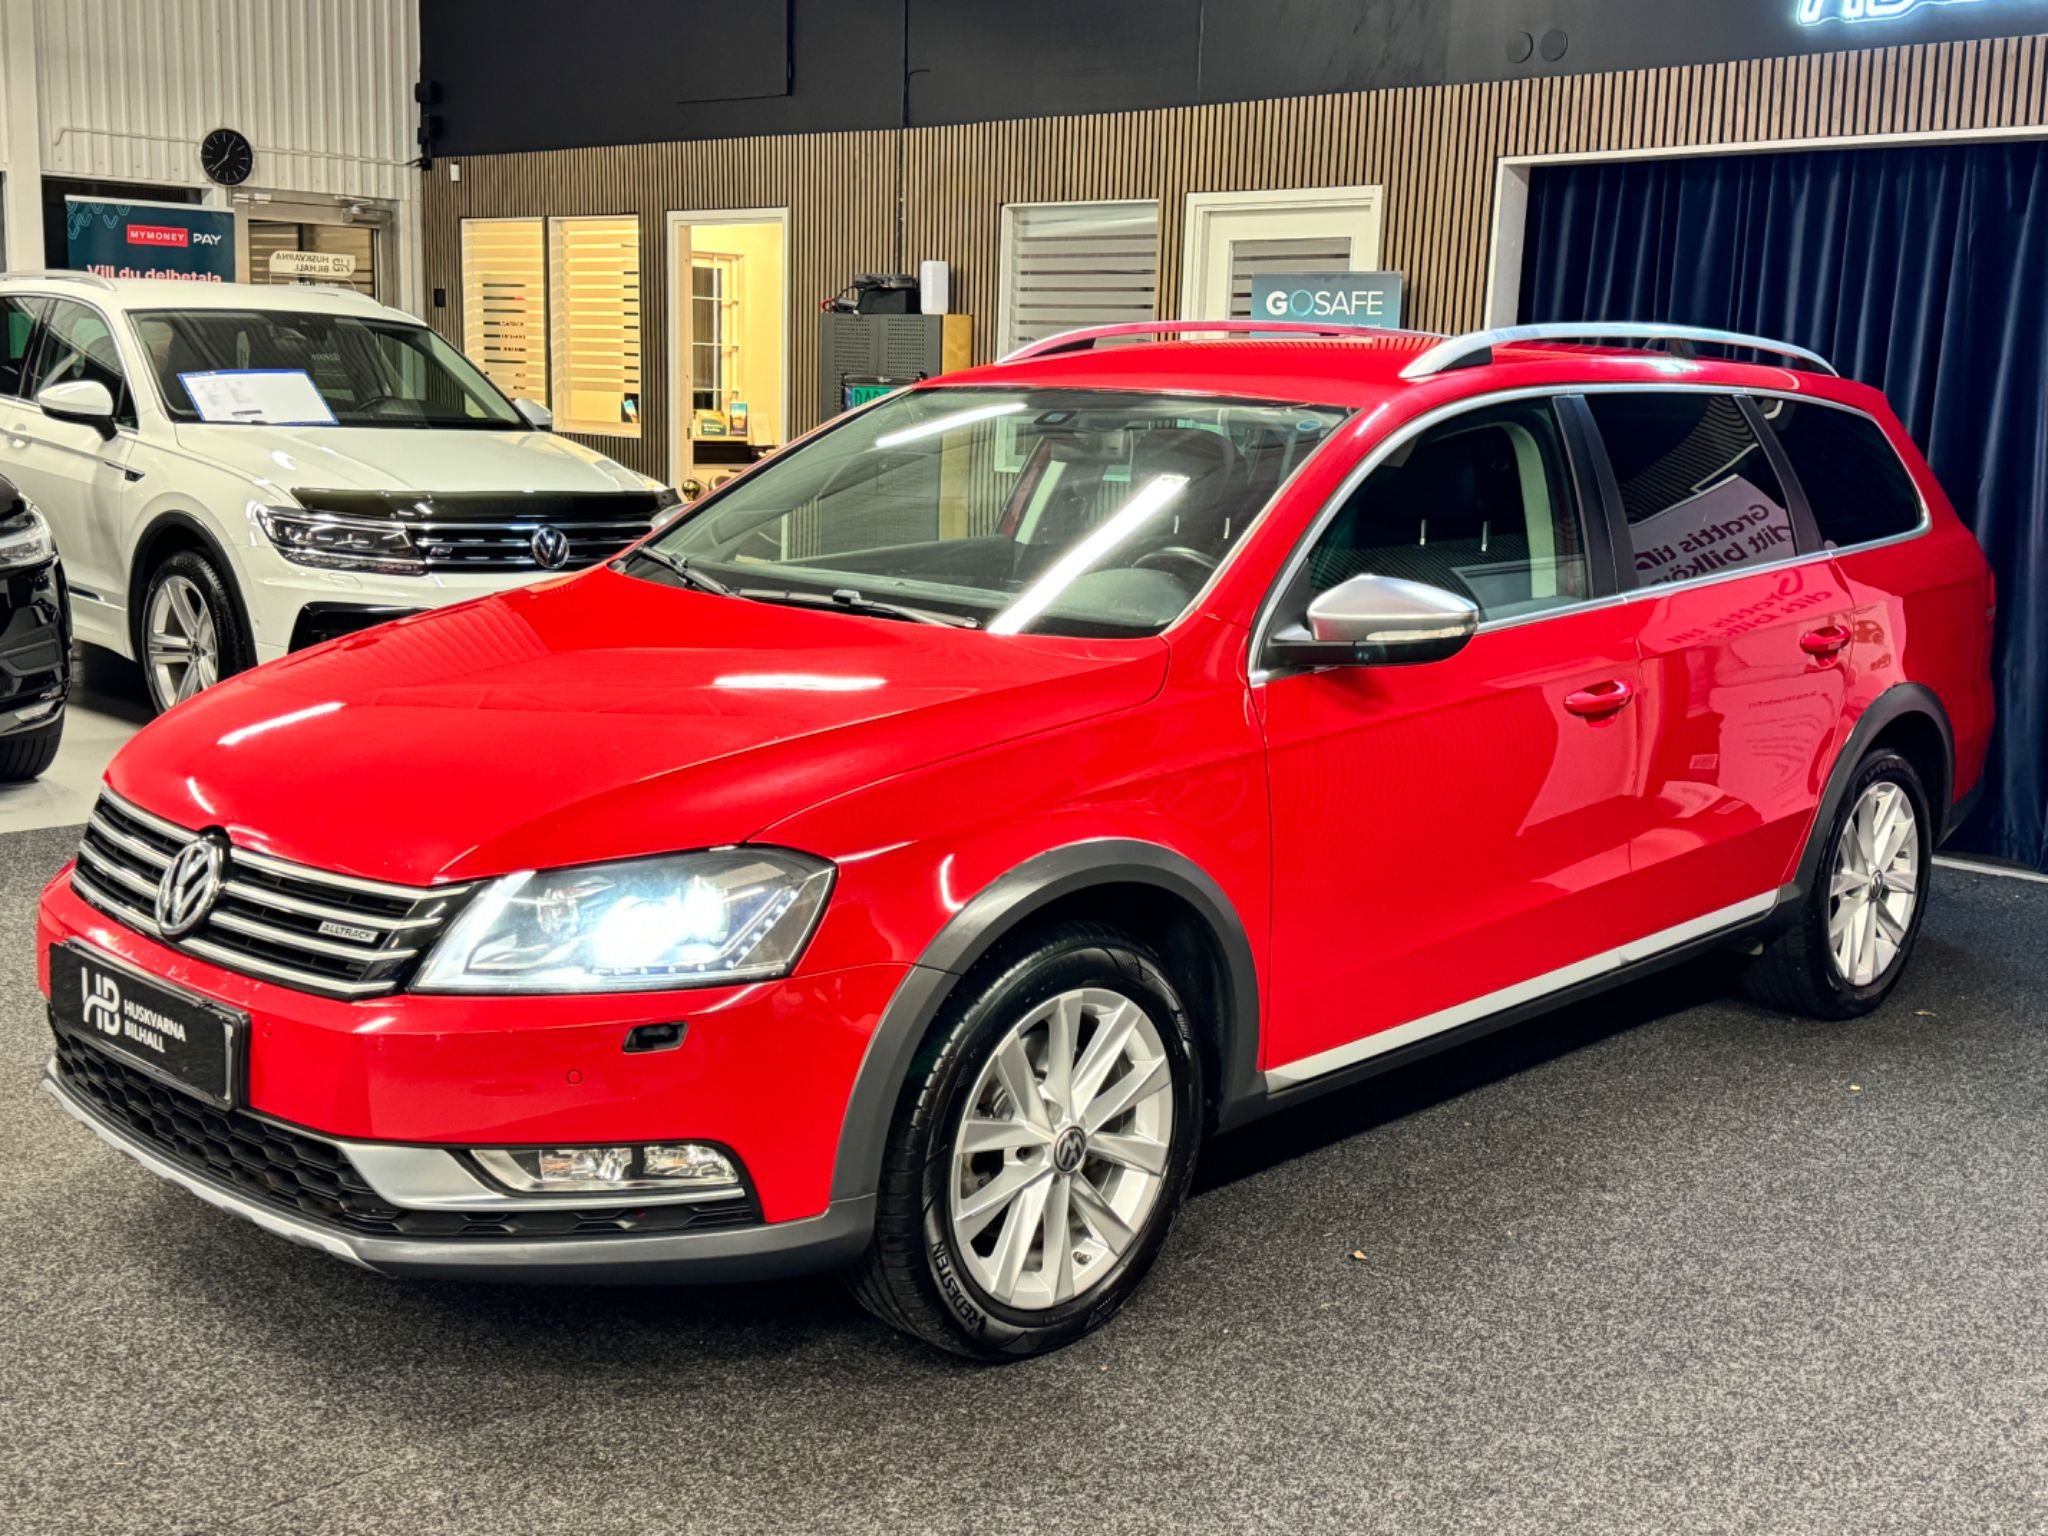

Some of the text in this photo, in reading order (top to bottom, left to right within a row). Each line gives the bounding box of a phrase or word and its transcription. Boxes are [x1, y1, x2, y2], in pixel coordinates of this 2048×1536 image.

[129, 231, 222, 246] MYMONEY PAY
[118, 266, 141, 280] du
[1265, 288, 1384, 317] GOSAFE
[322, 923, 373, 940] ALLTRACK
[124, 999, 187, 1042] HUSKVARNA
[124, 1020, 166, 1053] BILHALL
[932, 1241, 988, 1331] VREDESTEIN
